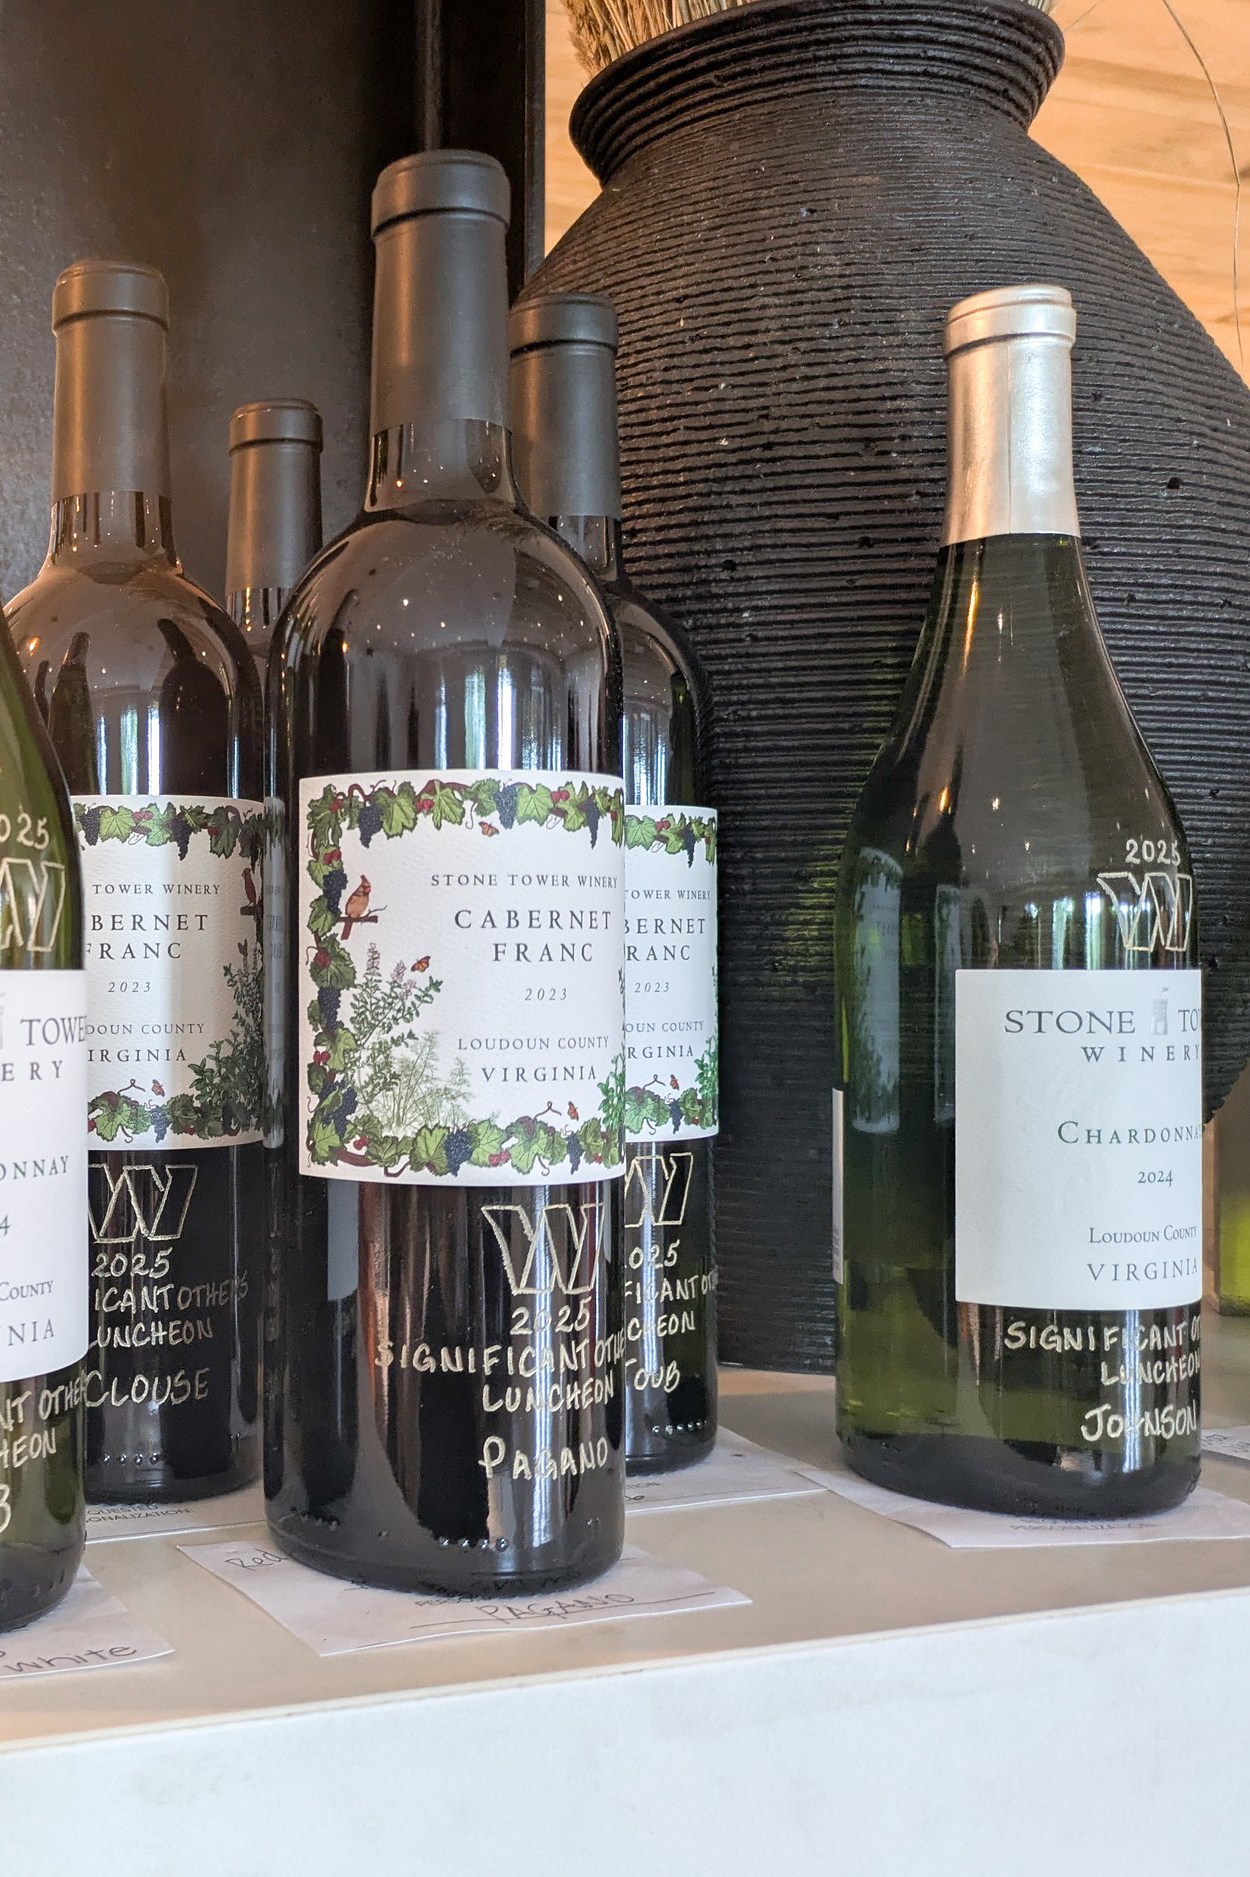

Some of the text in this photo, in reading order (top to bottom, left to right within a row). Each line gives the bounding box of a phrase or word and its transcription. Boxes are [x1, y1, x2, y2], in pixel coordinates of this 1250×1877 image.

[1125, 838, 1180, 866] 2025
[92, 884, 221, 896] TOWER WINERY
[431, 873, 617, 889] STONE TOWER WINERY
[677, 890, 710, 900] WINERY
[91, 914, 208, 932] BERNET
[454, 909, 612, 931] CABERNET
[493, 942, 594, 963] FRANC
[626, 945, 690, 961] RANC
[108, 981, 151, 993] 2023
[524, 988, 568, 1001] 2023
[634, 982, 670, 993] 2023
[19, 1016, 88, 1047] TOWE
[141, 1023, 204, 1035] COUNTY
[662, 1021, 704, 1032] COUNTY
[1004, 1010, 1136, 1035] STONE
[458, 1035, 609, 1052] LOUDOUN COUNTY
[627, 1045, 694, 1059] RGINIA
[1080, 1044, 1200, 1063] WINERY
[88, 1049, 187, 1062] IRGINIA
[481, 1065, 597, 1083] VIRGINIA
[1137, 1168, 1173, 1188] 2024
[1088, 1224, 1197, 1244] LOUDOUN COUNTY
[91, 1247, 173, 1278] 2025
[624, 1239, 680, 1270] 025
[1087, 1259, 1198, 1283] VIRGINIA
[509, 1296, 592, 1335] 2025
[627, 1310, 696, 1341] CHEON
[1004, 1320, 1188, 1353] SIGNIFICANT
[375, 1340, 590, 1378] SIGNIFICANT
[85, 1367, 210, 1407] CLOUSE
[483, 1373, 615, 1414] LUNCHEON
[1081, 1399, 1198, 1442] JOHNSON
[478, 1436, 609, 1480] PAGANO
[86, 1508, 195, 1523] ONALIZATION:
[87, 1503, 158, 1516] QUESTED
[477, 1593, 636, 1625] PAGANO
